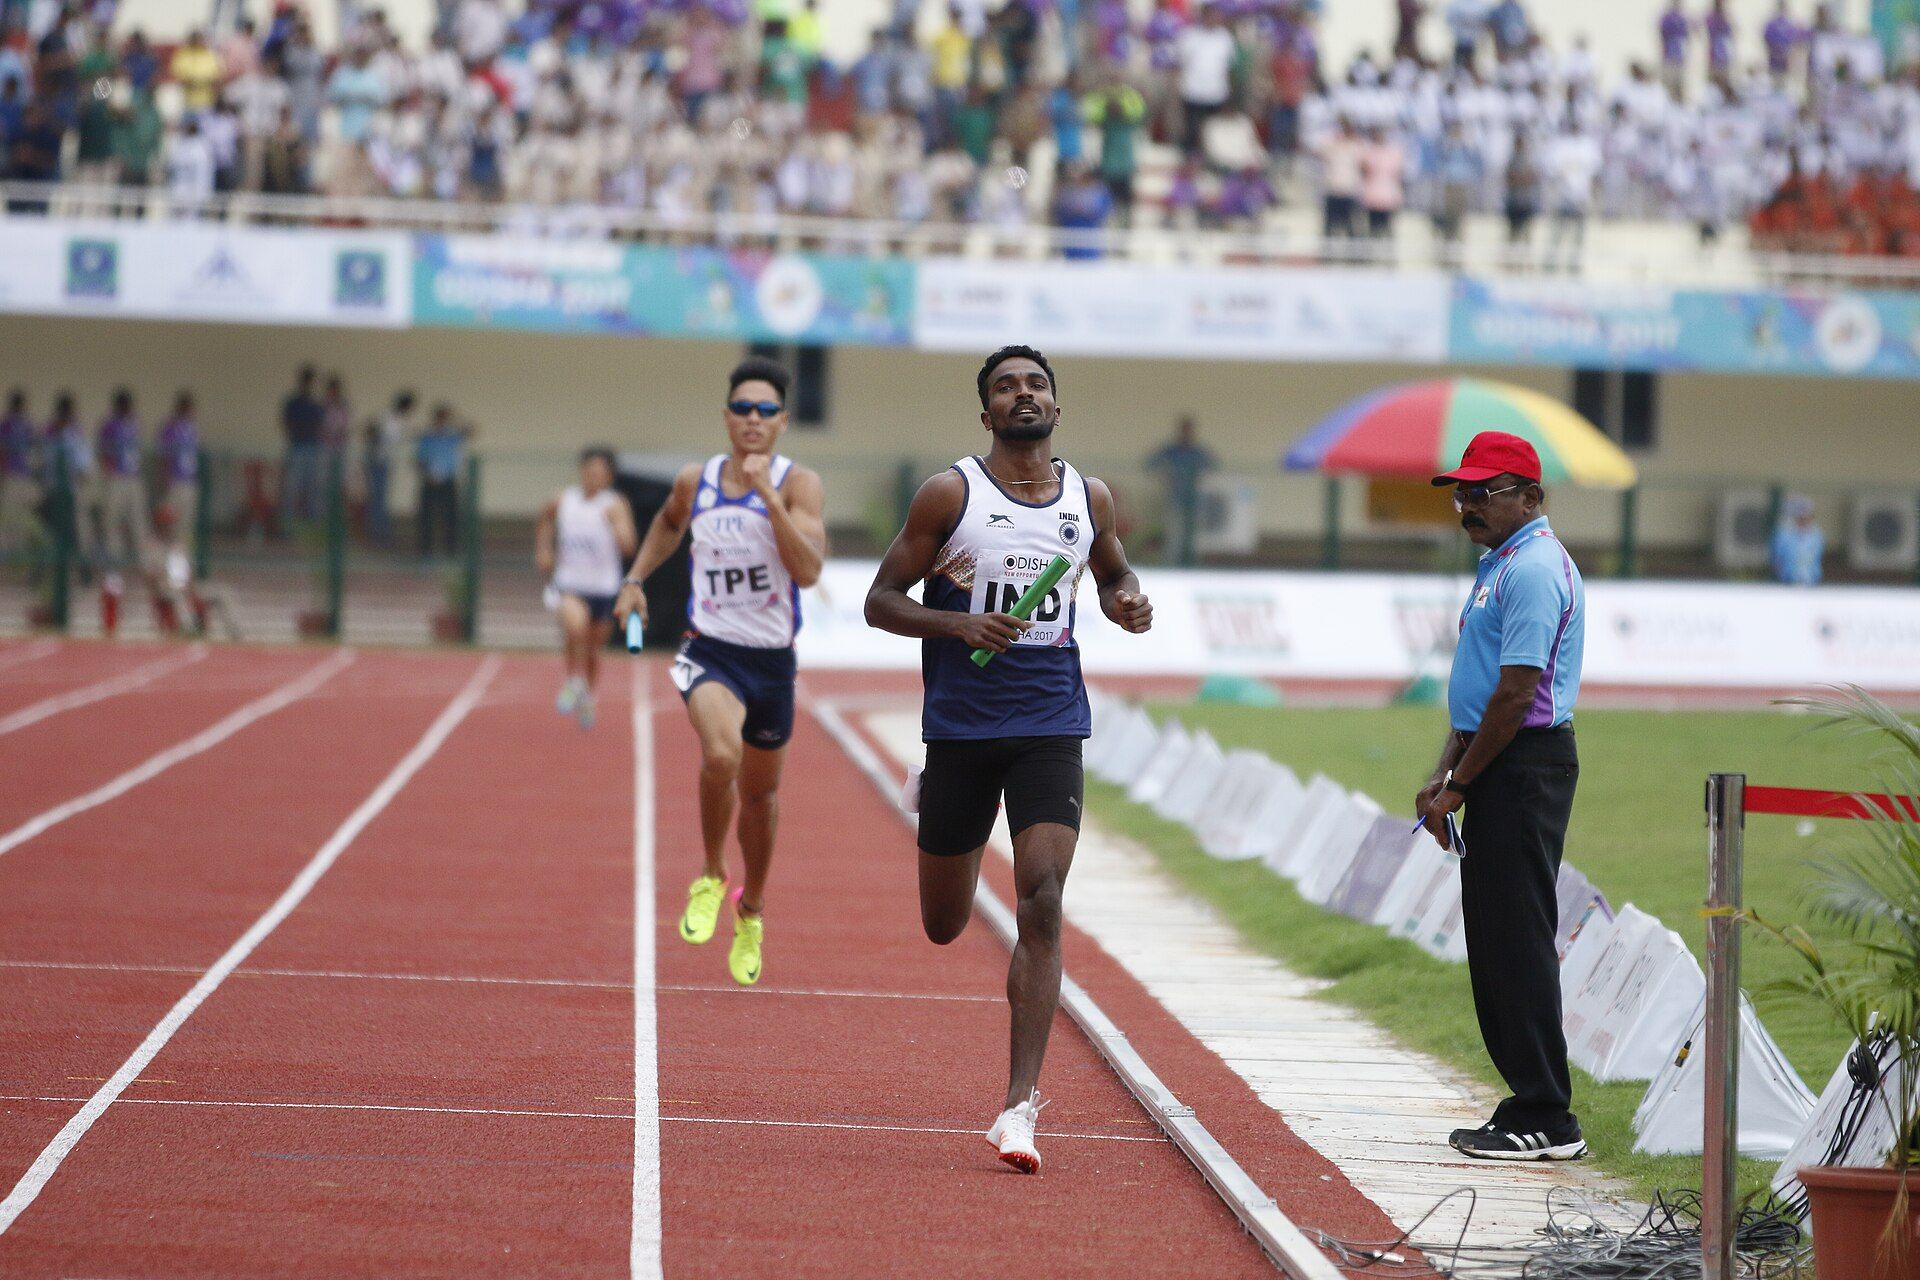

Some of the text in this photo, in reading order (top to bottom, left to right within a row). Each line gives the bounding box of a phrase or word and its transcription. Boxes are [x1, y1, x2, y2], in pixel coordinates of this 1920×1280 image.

[714, 515, 746, 533] TPE
[1058, 512, 1080, 522] INDIA
[1003, 554, 1049, 571] ODISH
[705, 565, 771, 596] TPE
[984, 581, 1061, 622] IND
[1034, 631, 1054, 641] 2017
